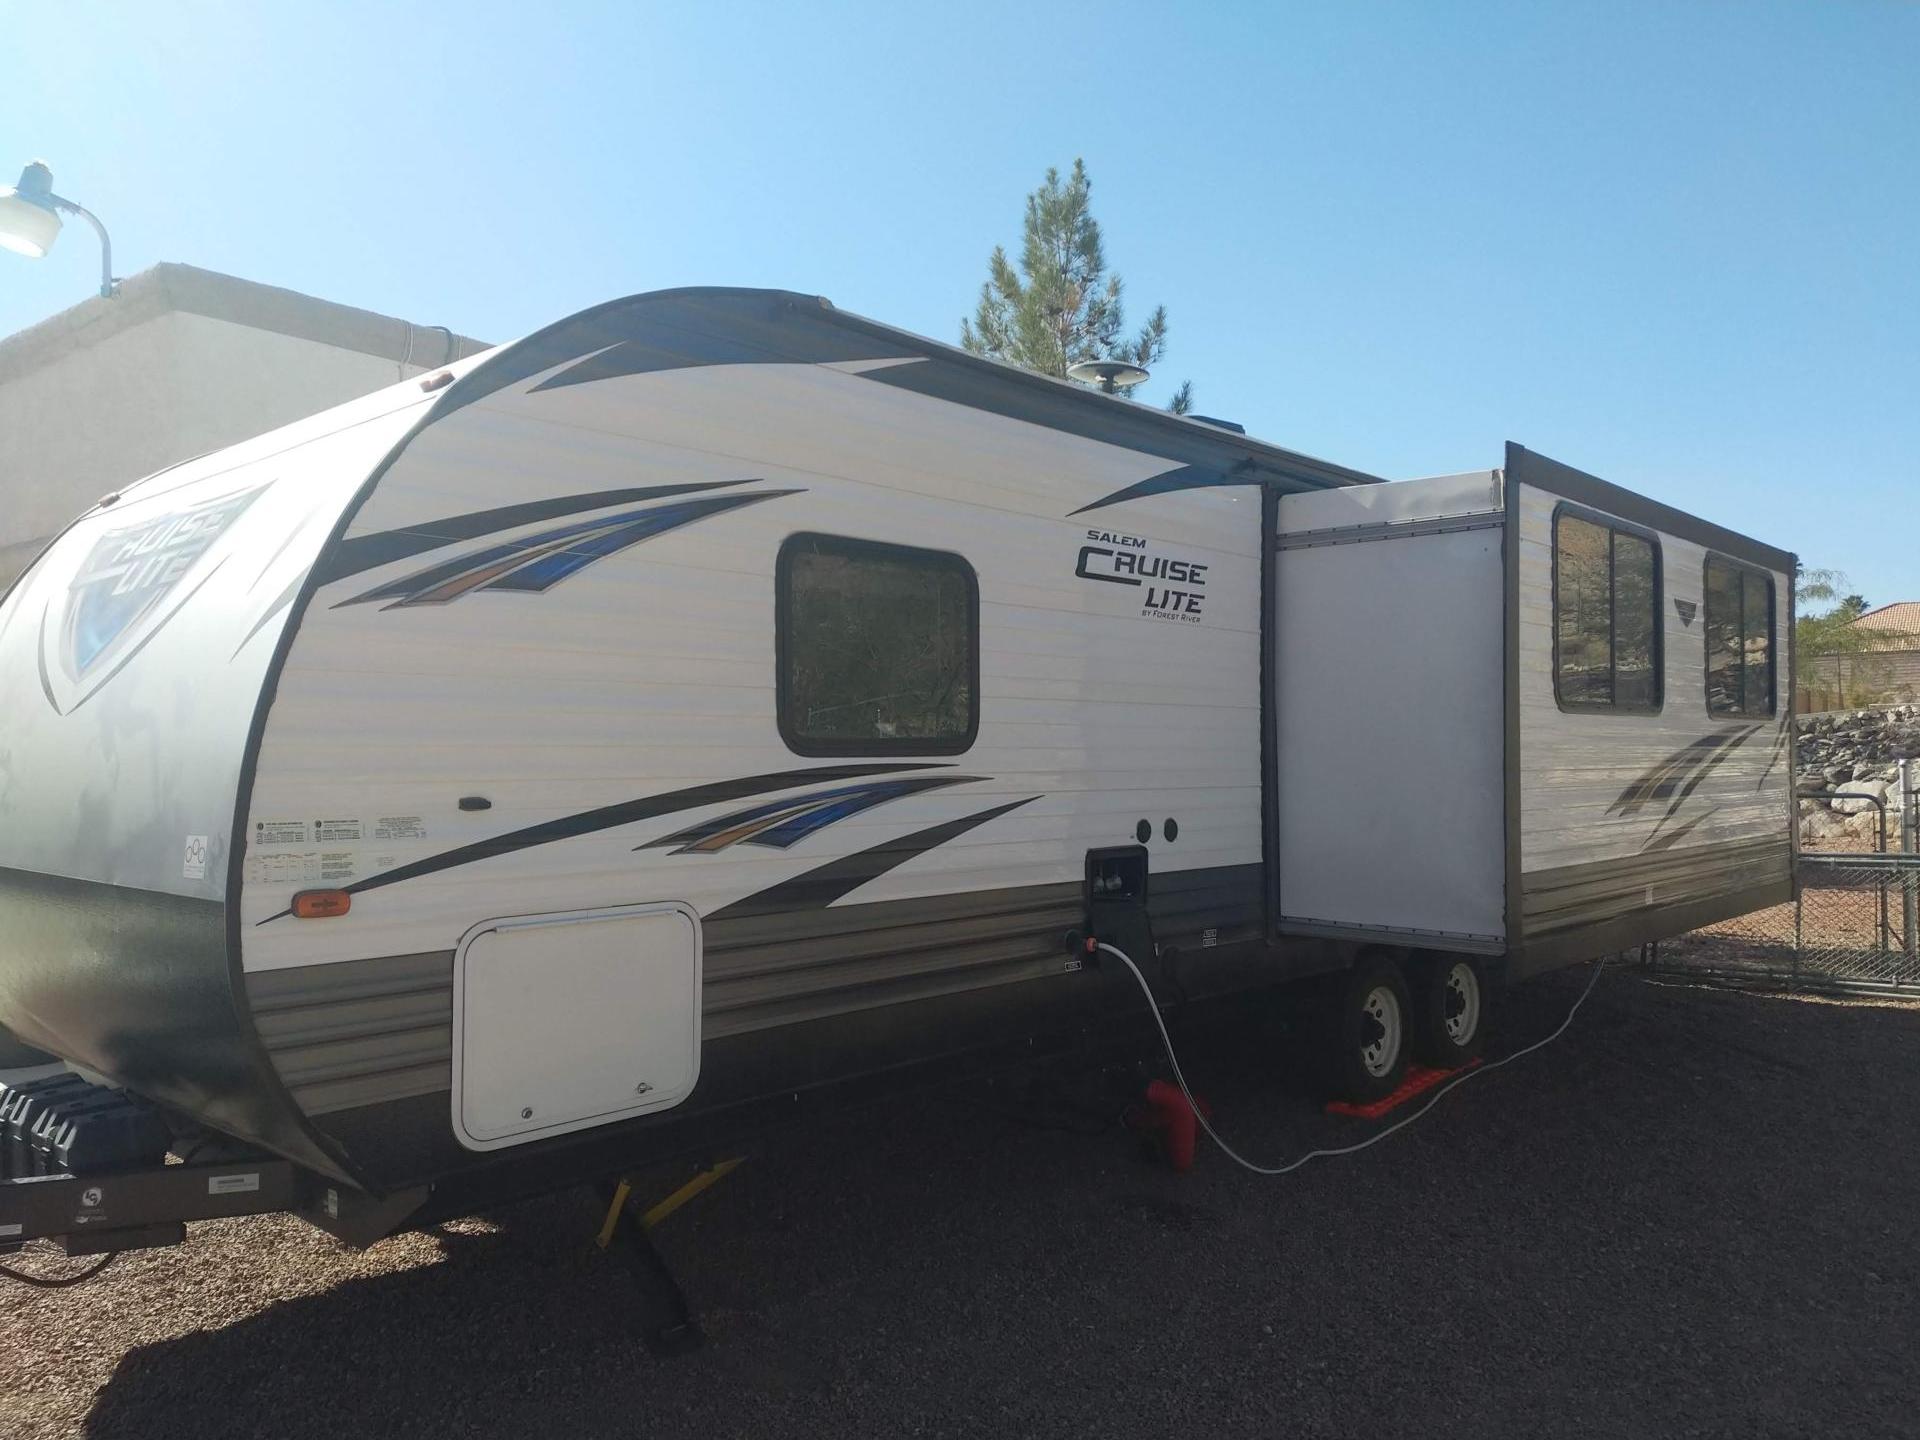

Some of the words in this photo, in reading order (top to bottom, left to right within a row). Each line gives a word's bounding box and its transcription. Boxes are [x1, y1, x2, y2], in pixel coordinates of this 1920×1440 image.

[1086, 529, 1147, 549] SALEM
[1074, 545, 1209, 587] CRUISE
[1144, 587, 1206, 614] LITE
[1142, 609, 1152, 617] BY
[1153, 610, 1180, 621] FOREST
[1180, 613, 1201, 623] RIVER
